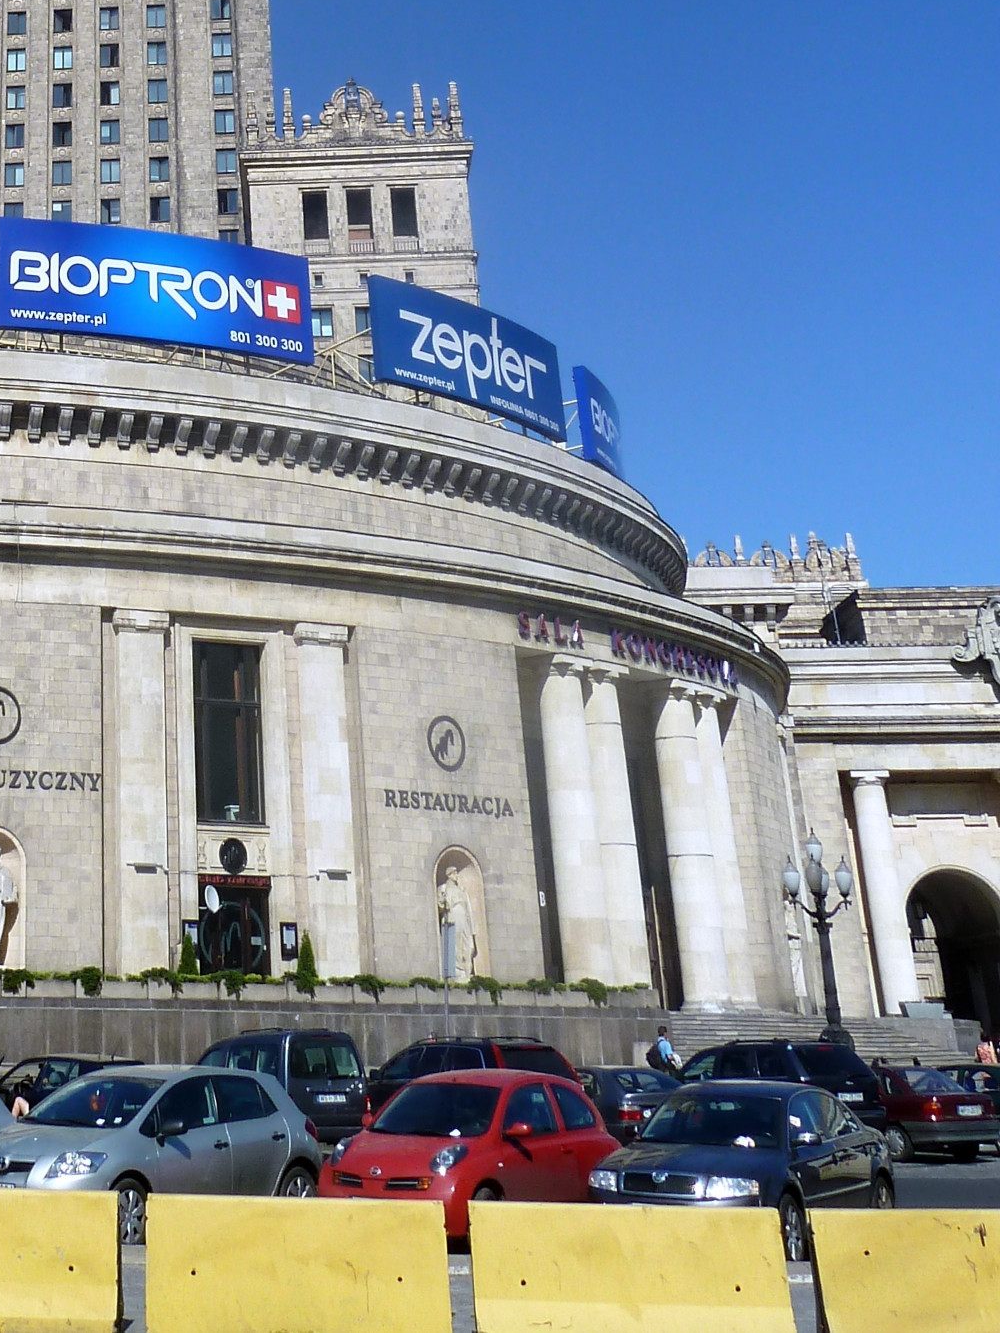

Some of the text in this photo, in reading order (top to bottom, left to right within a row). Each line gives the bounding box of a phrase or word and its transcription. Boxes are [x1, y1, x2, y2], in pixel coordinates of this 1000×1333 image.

[9, 250, 264, 320] BIOPTRON
[10, 307, 107, 327] www.zepter.pl
[230, 330, 303, 353] 801 300 300
[400, 308, 546, 400] zepter
[394, 367, 456, 391] www.zepter.pl
[517, 611, 585, 650] SALA
[384, 789, 514, 819] RESTAURACJA
[539, 890, 546, 907] B
